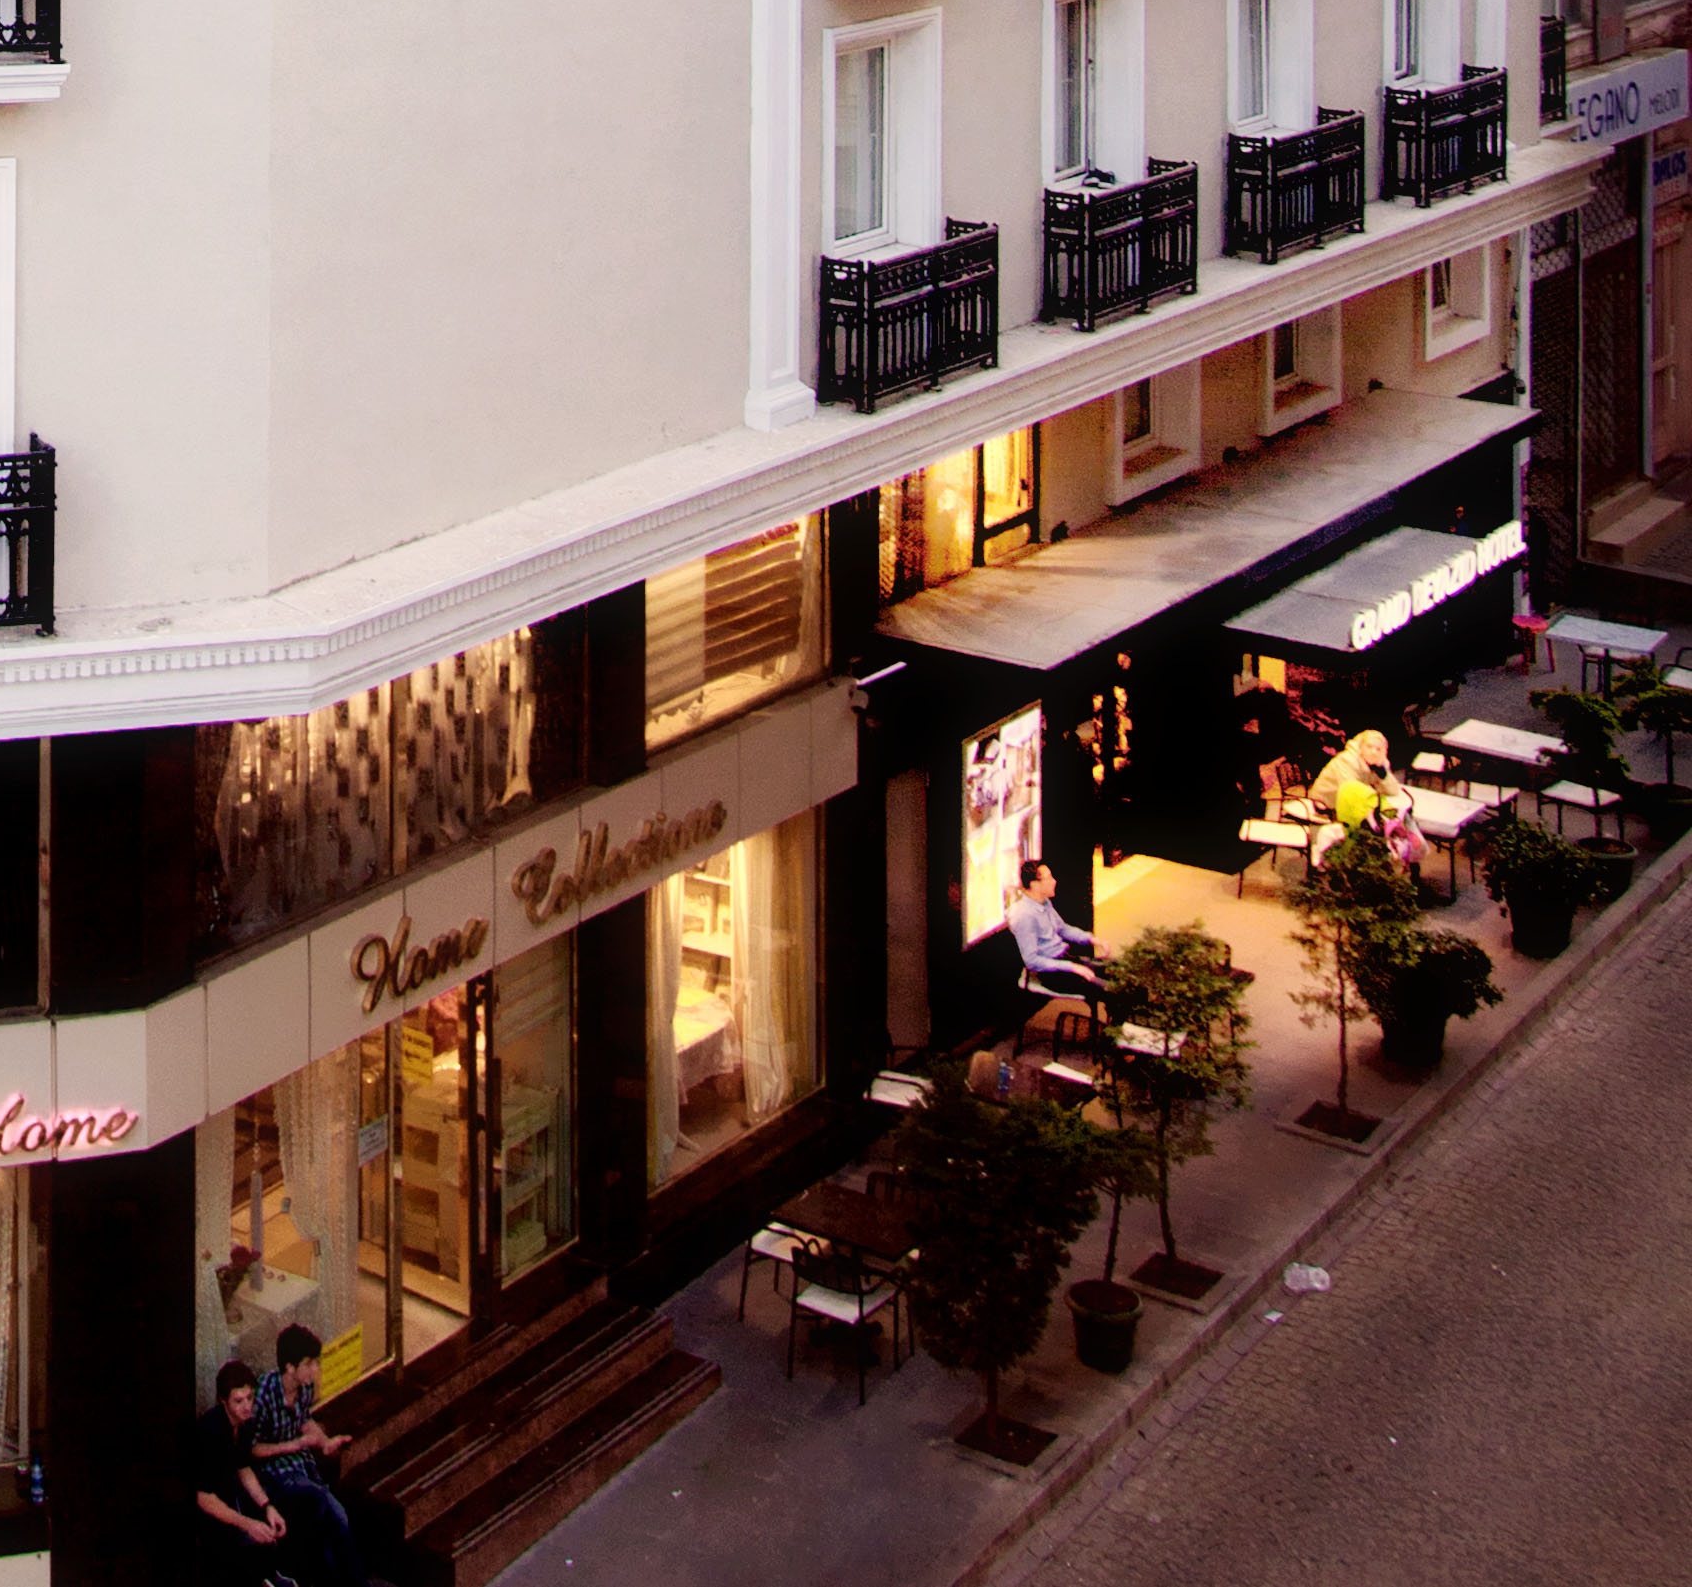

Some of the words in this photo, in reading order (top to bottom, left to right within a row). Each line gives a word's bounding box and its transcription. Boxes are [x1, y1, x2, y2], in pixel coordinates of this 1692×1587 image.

[1352, 590, 1412, 651] GRAND
[1476, 520, 1528, 575] HOTEL
[350, 916, 490, 1014] Home
[512, 799, 727, 927] Collections
